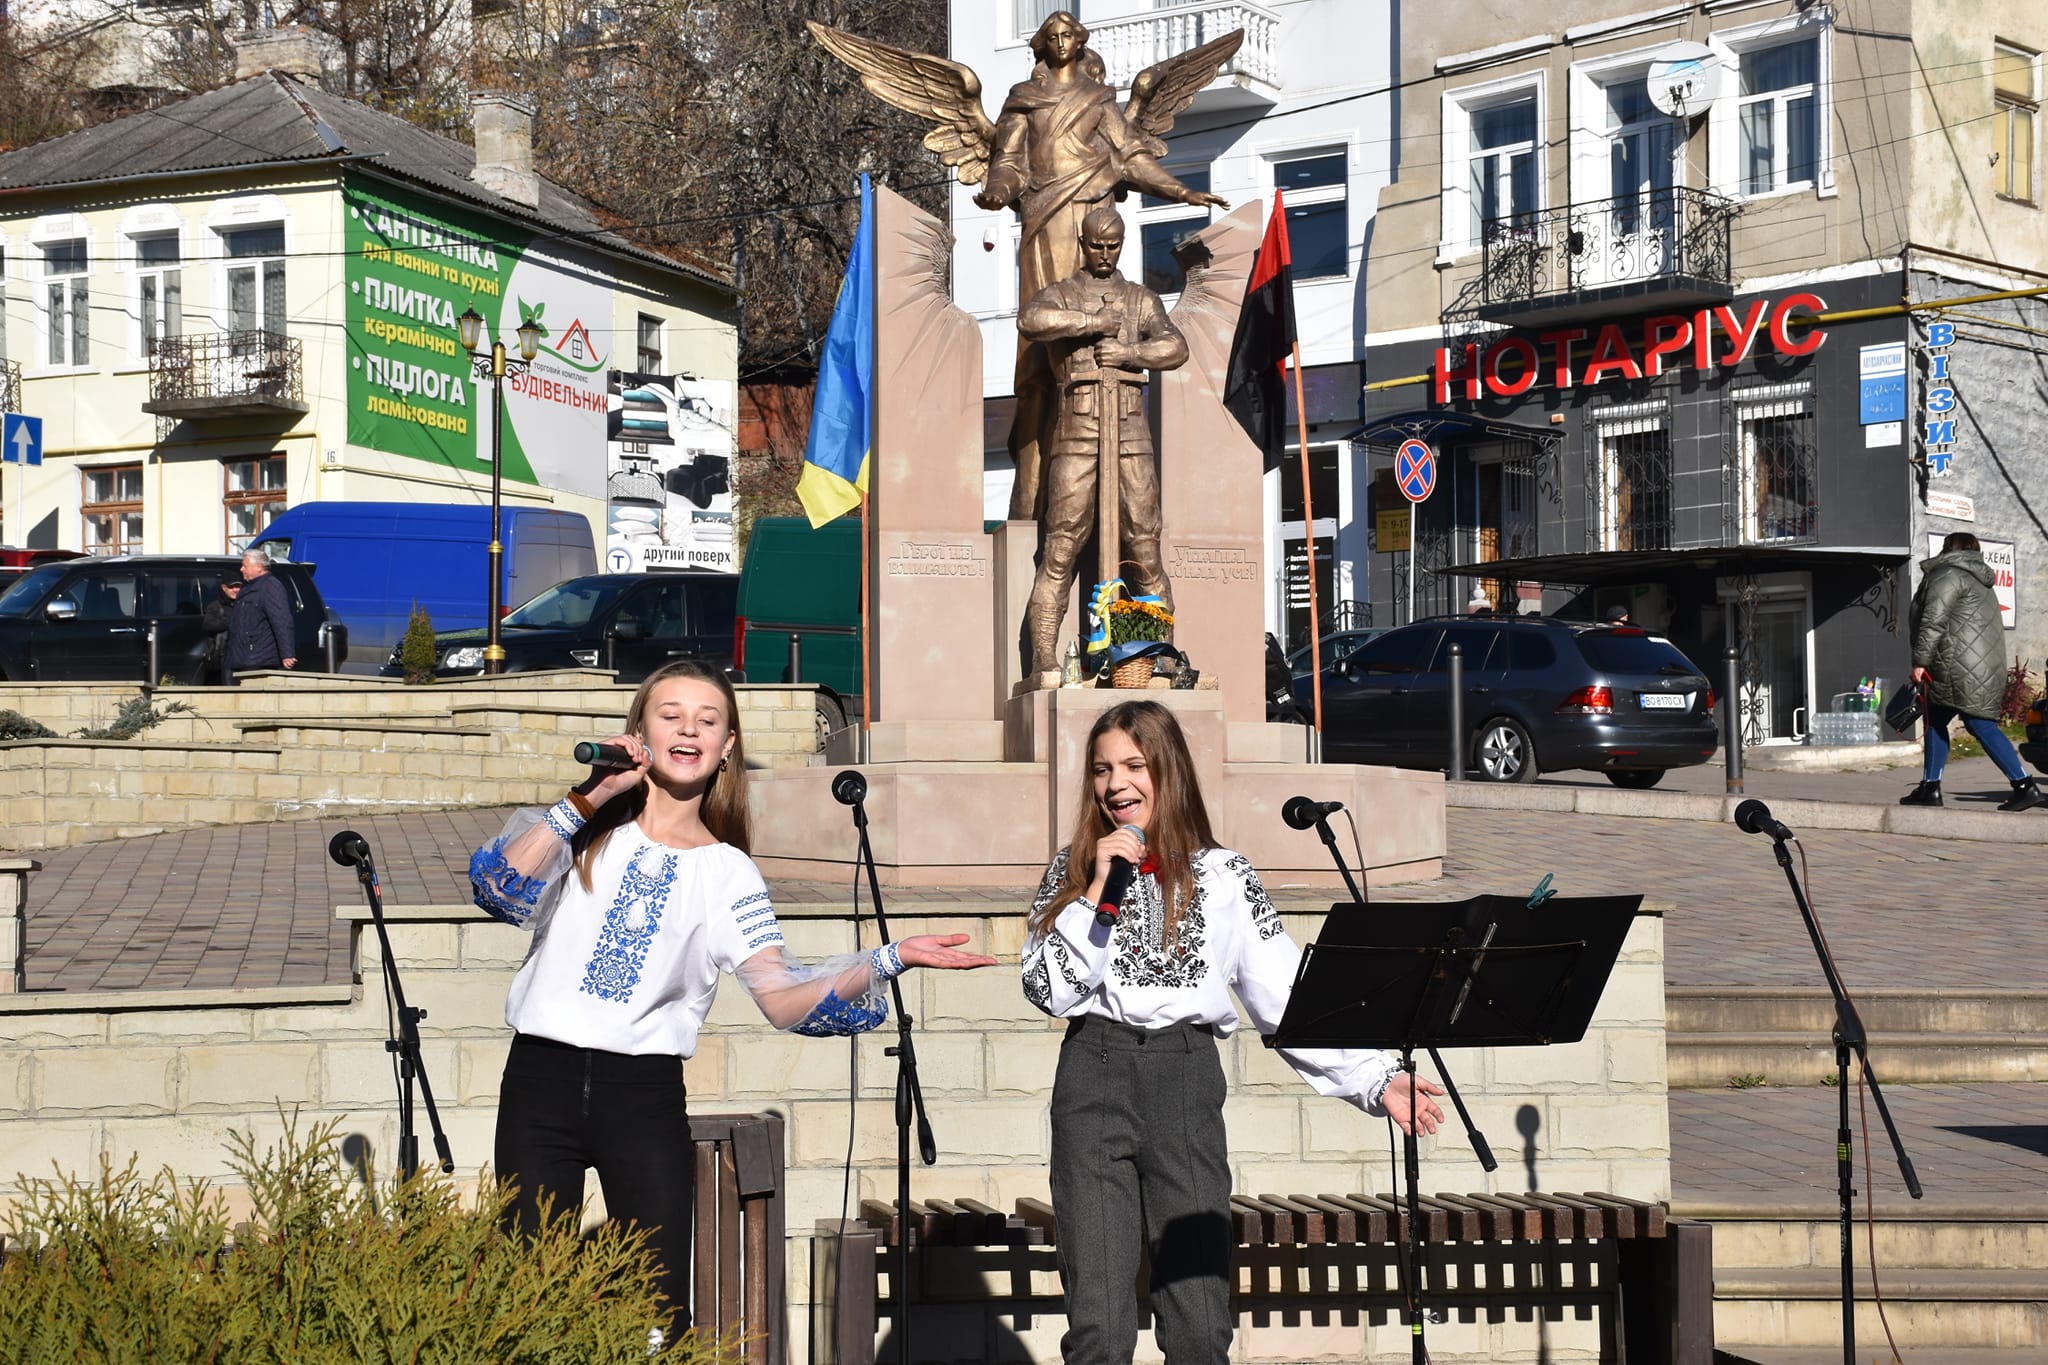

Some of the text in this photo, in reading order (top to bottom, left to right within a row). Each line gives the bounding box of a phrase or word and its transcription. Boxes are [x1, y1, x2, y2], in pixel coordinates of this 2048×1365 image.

[364, 202, 499, 272] САНТЕХНІКА
[363, 241, 500, 297] для ванни та кухні
[364, 276, 458, 330] ПЛИТКА
[364, 317, 456, 357] керамічна
[1434, 293, 1830, 404] НОТАРІУС
[366, 354, 466, 406] ПІДЛОГА
[512, 371, 608, 414] БУДІВЕЛЬНИК
[533, 362, 589, 383] торговий комплекс
[367, 395, 468, 434] ламінована
[1926, 323, 1956, 476] ВІЗИТ
[326, 450, 336, 463] 16
[644, 547, 731, 566] другий поверх
